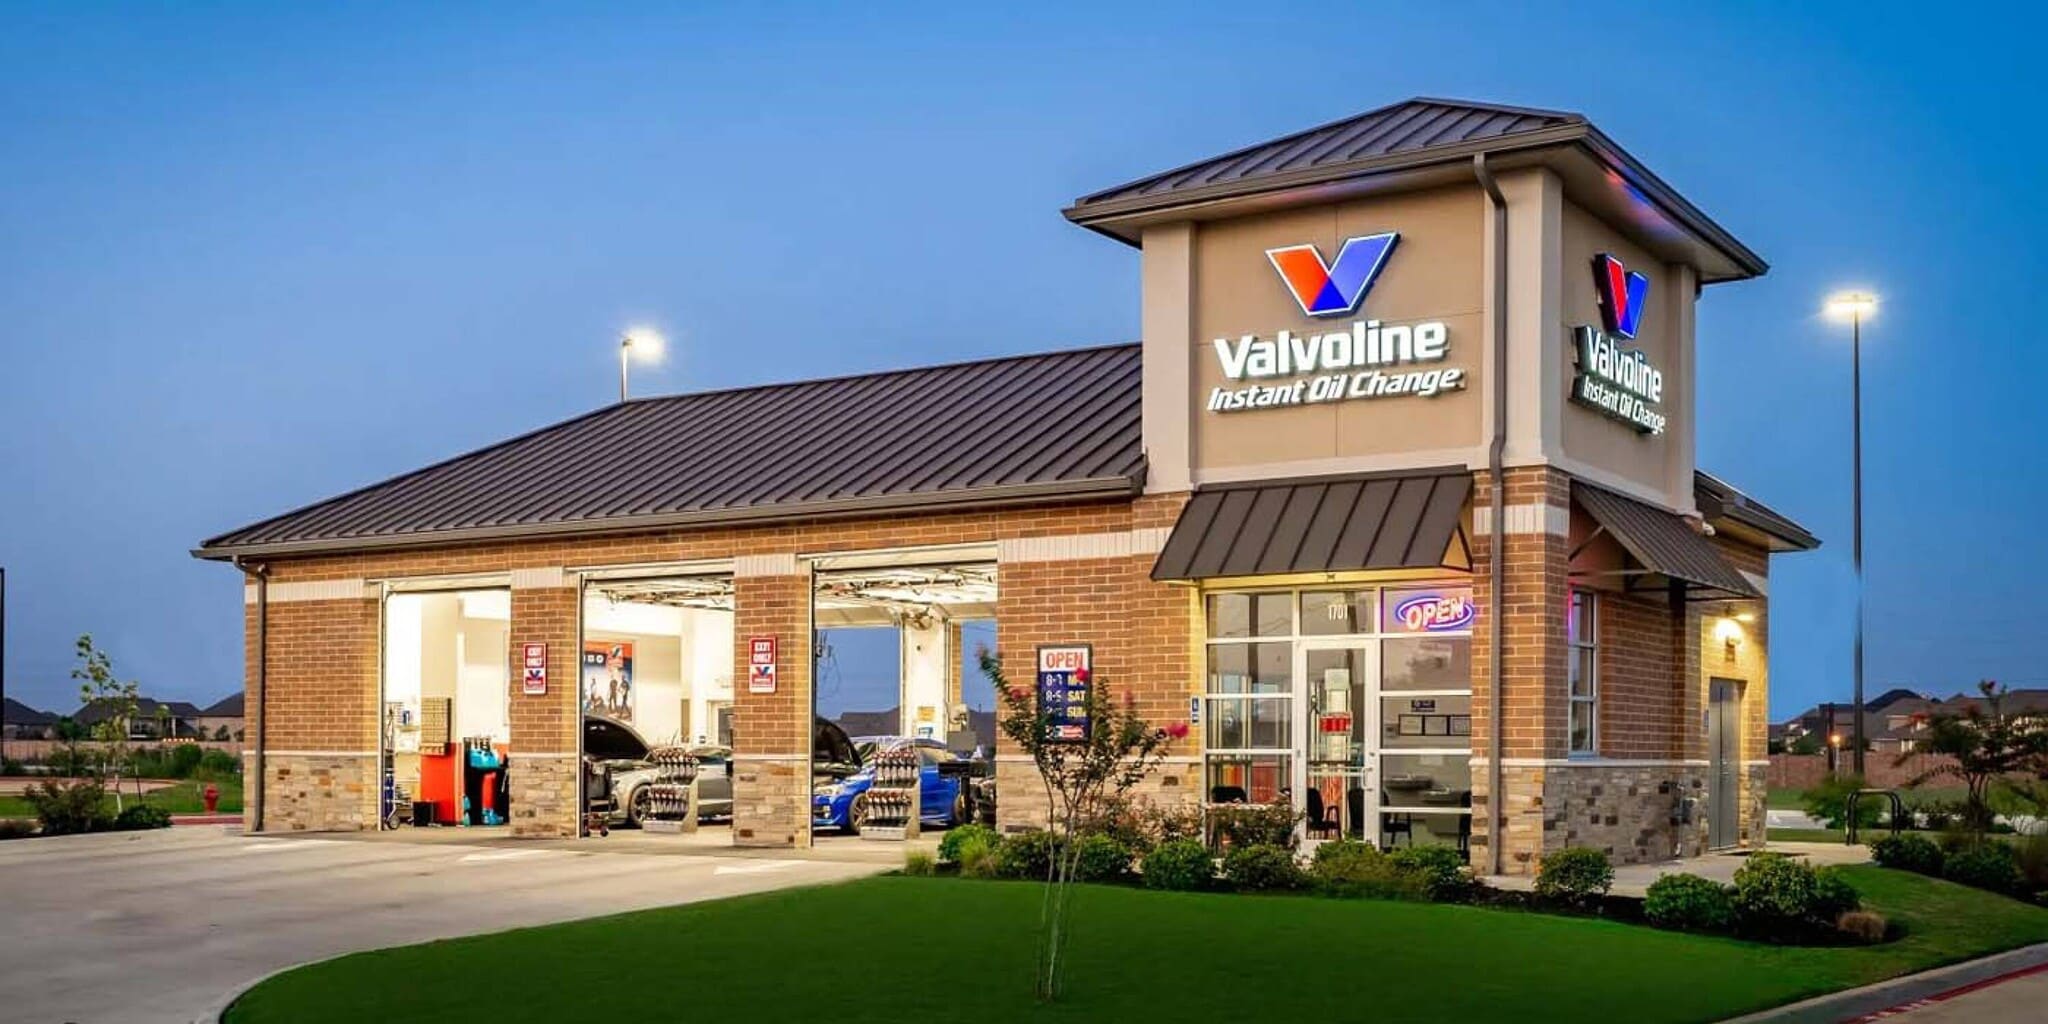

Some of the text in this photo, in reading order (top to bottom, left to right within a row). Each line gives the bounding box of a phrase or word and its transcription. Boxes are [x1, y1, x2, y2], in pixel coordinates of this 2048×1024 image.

[1213, 320, 1450, 380] Valvoline
[1585, 325, 1663, 403] Valvoline
[1206, 366, 1465, 412] Instant Oil Change
[1583, 376, 1666, 436] Instant Oil Change
[1328, 604, 1349, 621] 1701
[1405, 596, 1465, 631] OPEN
[1045, 651, 1084, 669] OPEN
[1067, 689, 1087, 703] SAT
